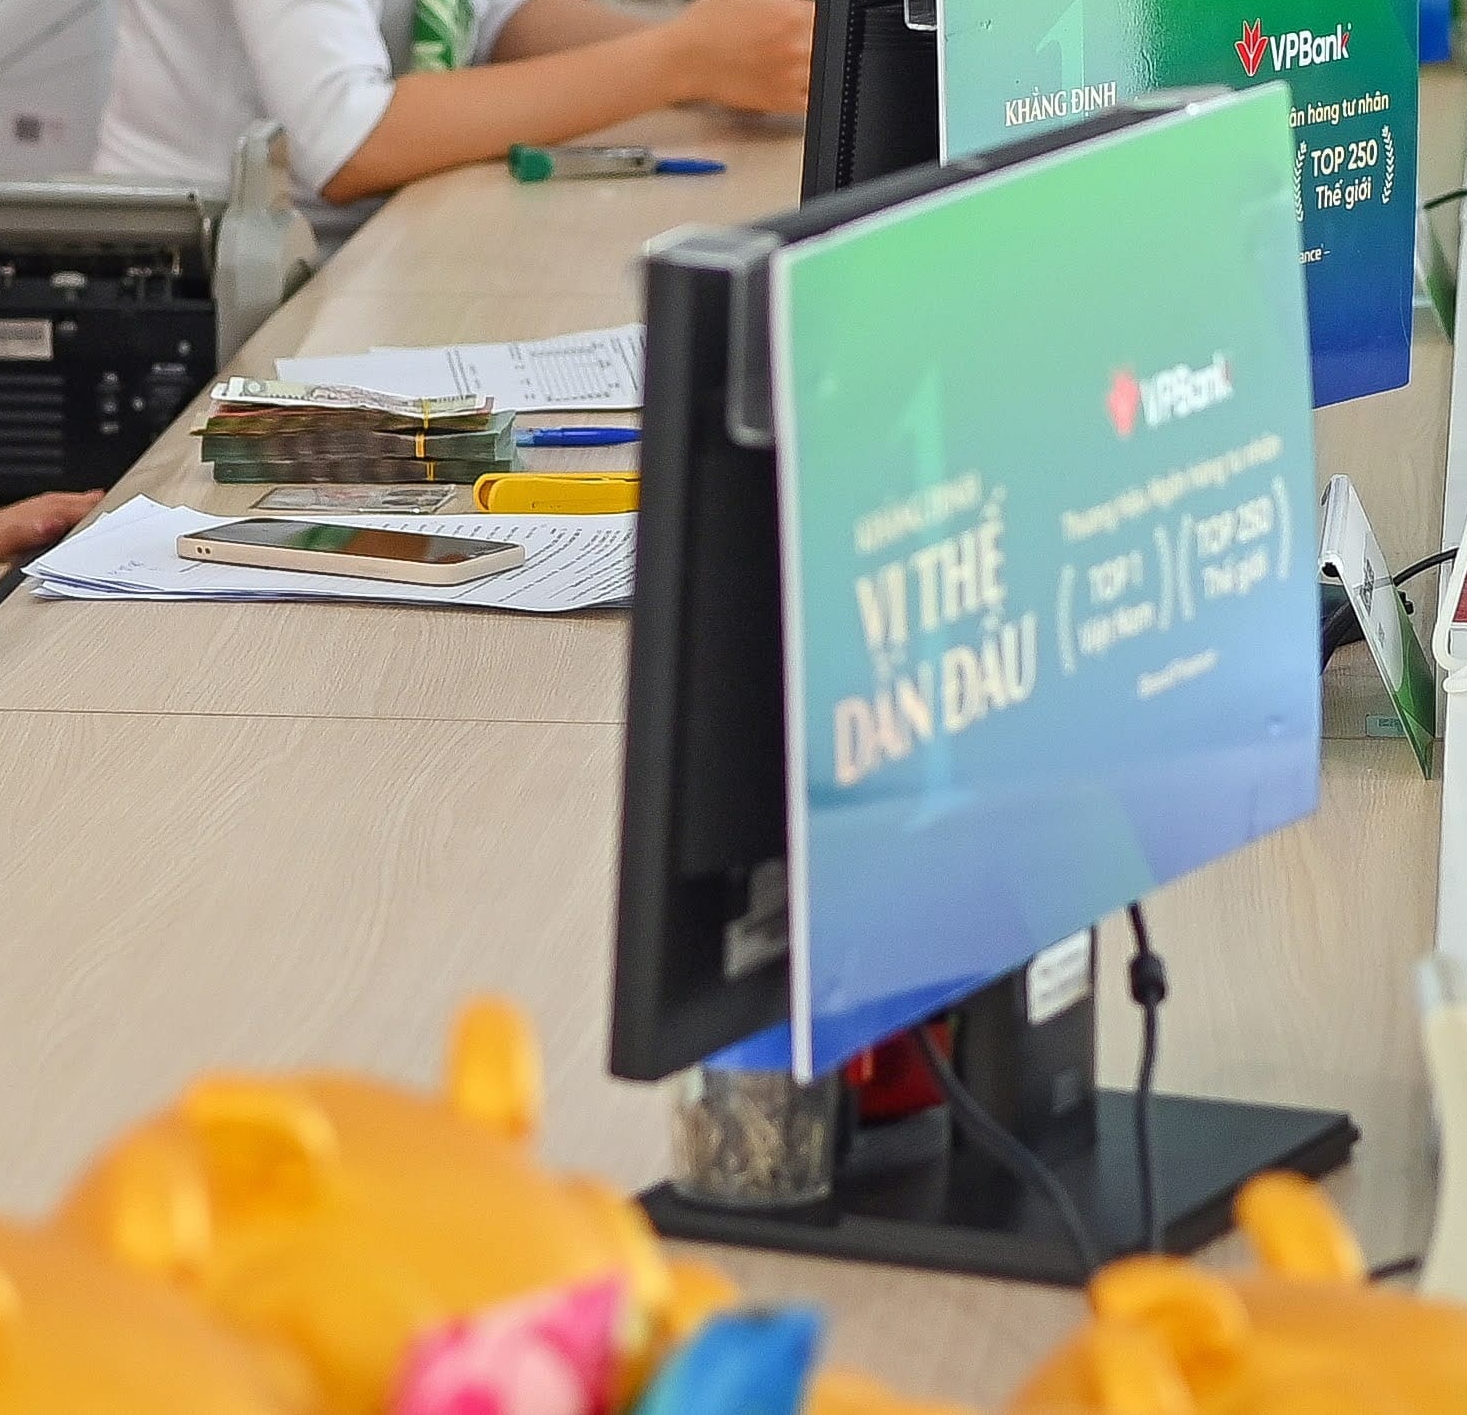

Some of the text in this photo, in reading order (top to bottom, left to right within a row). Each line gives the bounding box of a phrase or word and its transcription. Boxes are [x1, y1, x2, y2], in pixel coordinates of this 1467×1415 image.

[1270, 24, 1352, 72] VPBank
[1005, 81, 1116, 127] KHẲNG ĐỊNH
[1307, 99, 1339, 126] hàng
[1342, 101, 1357, 118] tư
[1358, 91, 1390, 114] nhân
[1311, 139, 1378, 178] TOP 250
[1315, 176, 1372, 210] Thế giới
[1140, 348, 1234, 429] VPBank
